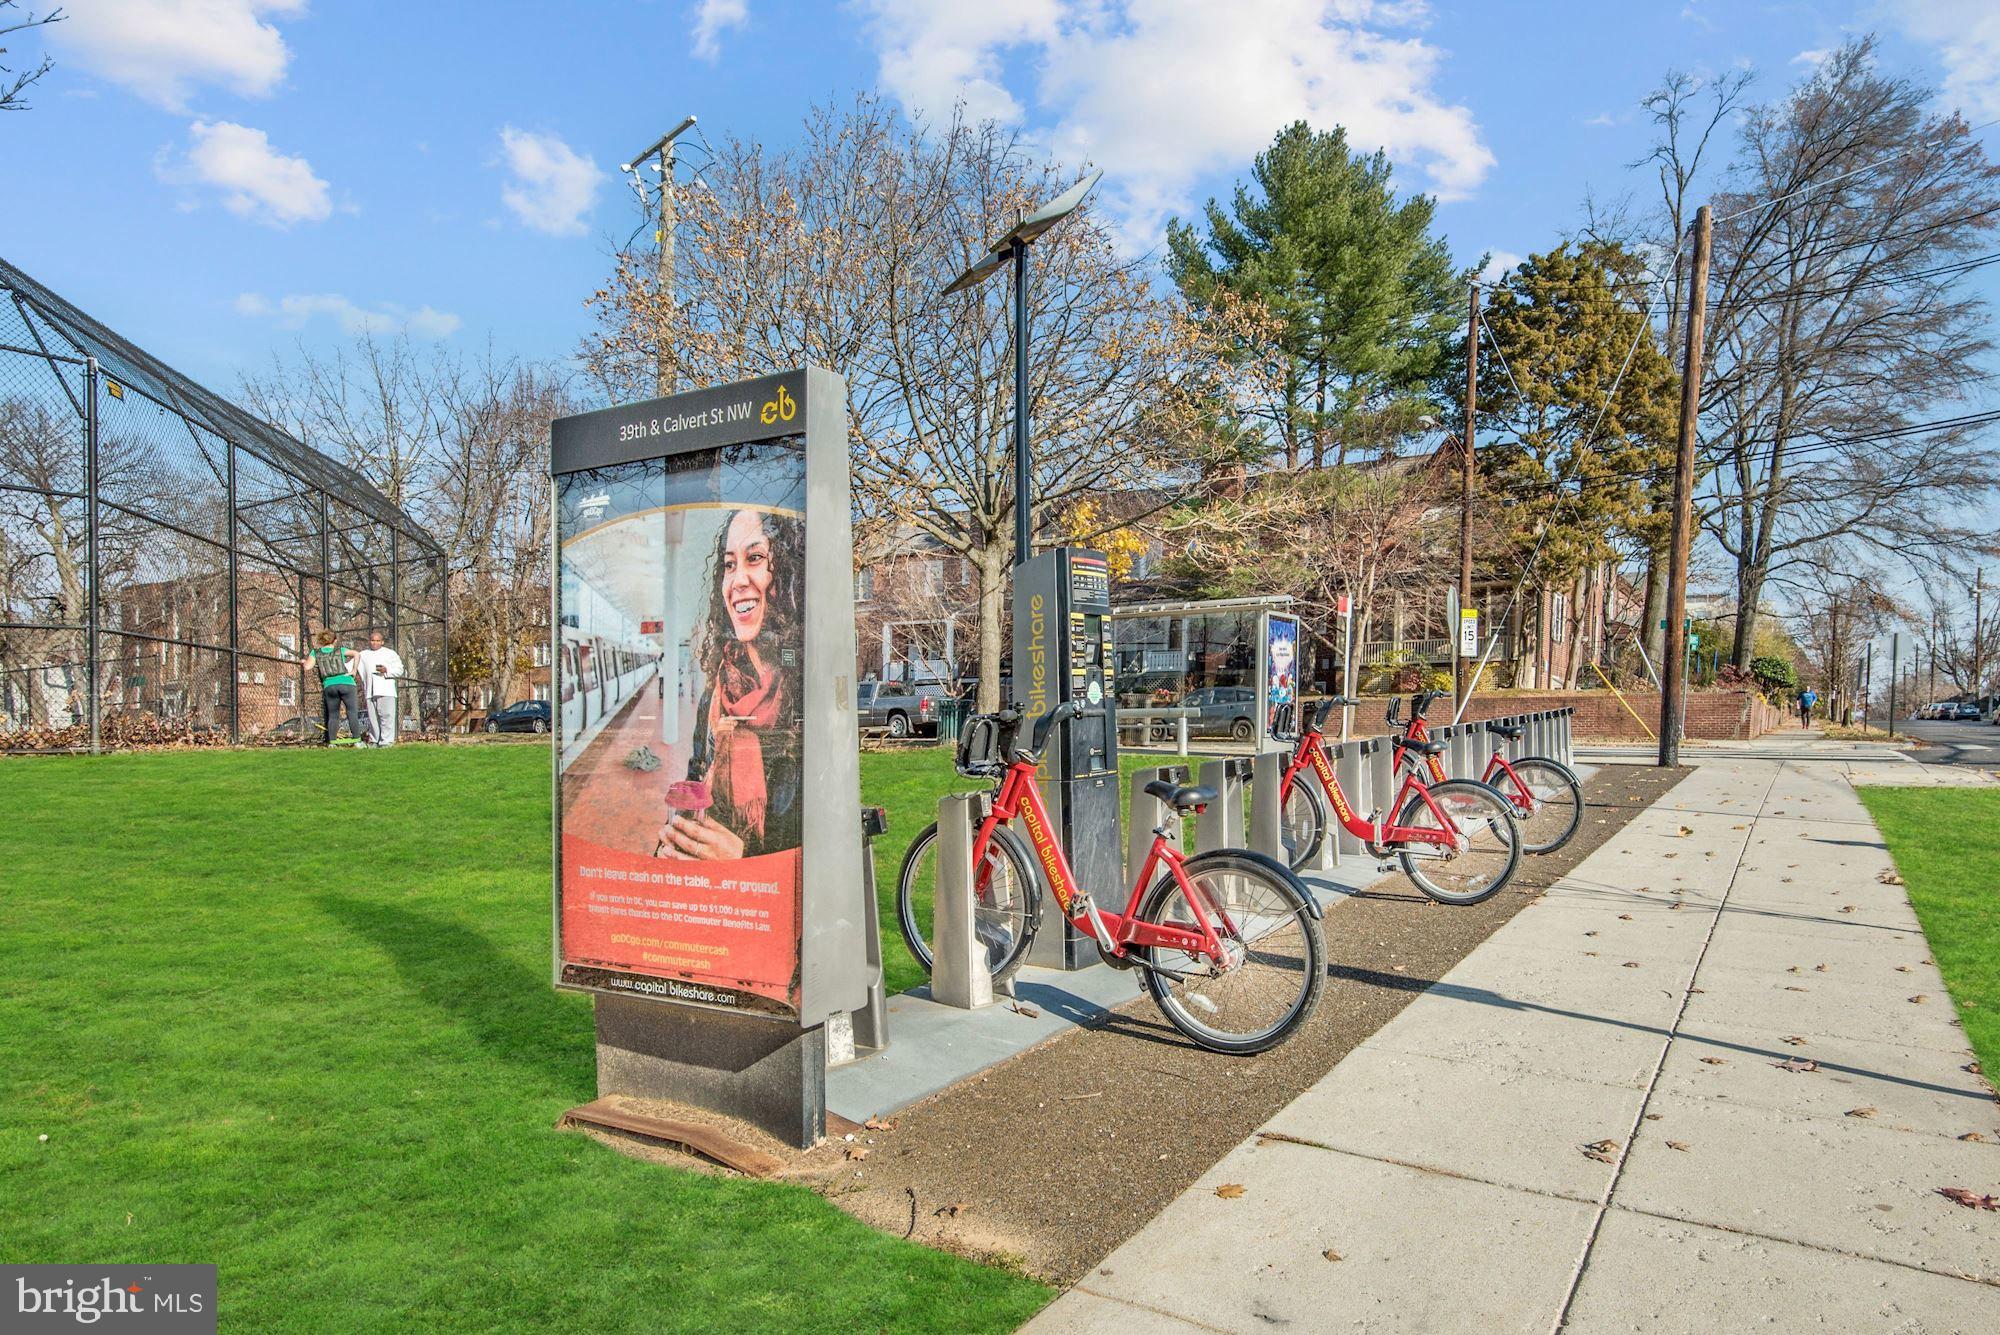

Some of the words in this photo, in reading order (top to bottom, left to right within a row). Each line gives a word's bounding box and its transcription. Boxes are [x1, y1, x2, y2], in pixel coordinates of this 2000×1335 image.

[619, 421, 647, 441] 39th
[650, 419, 660, 435] &
[663, 411, 708, 433] Calvert
[710, 408, 723, 426] St
[727, 401, 753, 422] NW
[1464, 630, 1475, 641] 15
[1026, 593, 1047, 720] bikeshare
[1328, 779, 1350, 822] bikeshare
[1021, 797, 1048, 844] capital
[1041, 844, 1071, 910] bikeshare
[579, 866, 603, 879] Don't
[604, 867, 627, 881] leave
[629, 871, 649, 883] cash
[651, 873, 663, 884] on
[665, 873, 682, 886] the
[684, 875, 712, 890] table,
[739, 881, 780, 895] ground.
[596, 894, 608, 903] you
[645, 899, 657, 908] you
[659, 900, 671, 908] can
[672, 902, 688, 910] save
[689, 903, 698, 912] up
[700, 904, 708, 912] to
[709, 903, 733, 914] $1,000
[740, 909, 757, 918] year
[758, 910, 769, 918] on
[628, 908, 651, 919] thanks
[652, 911, 659, 920] to
[661, 911, 672, 921] the
[674, 914, 683, 922] DC
[684, 914, 722, 926] Commuter
[722, 918, 754, 930] Benefits
[643, 951, 711, 970] #commutercash
